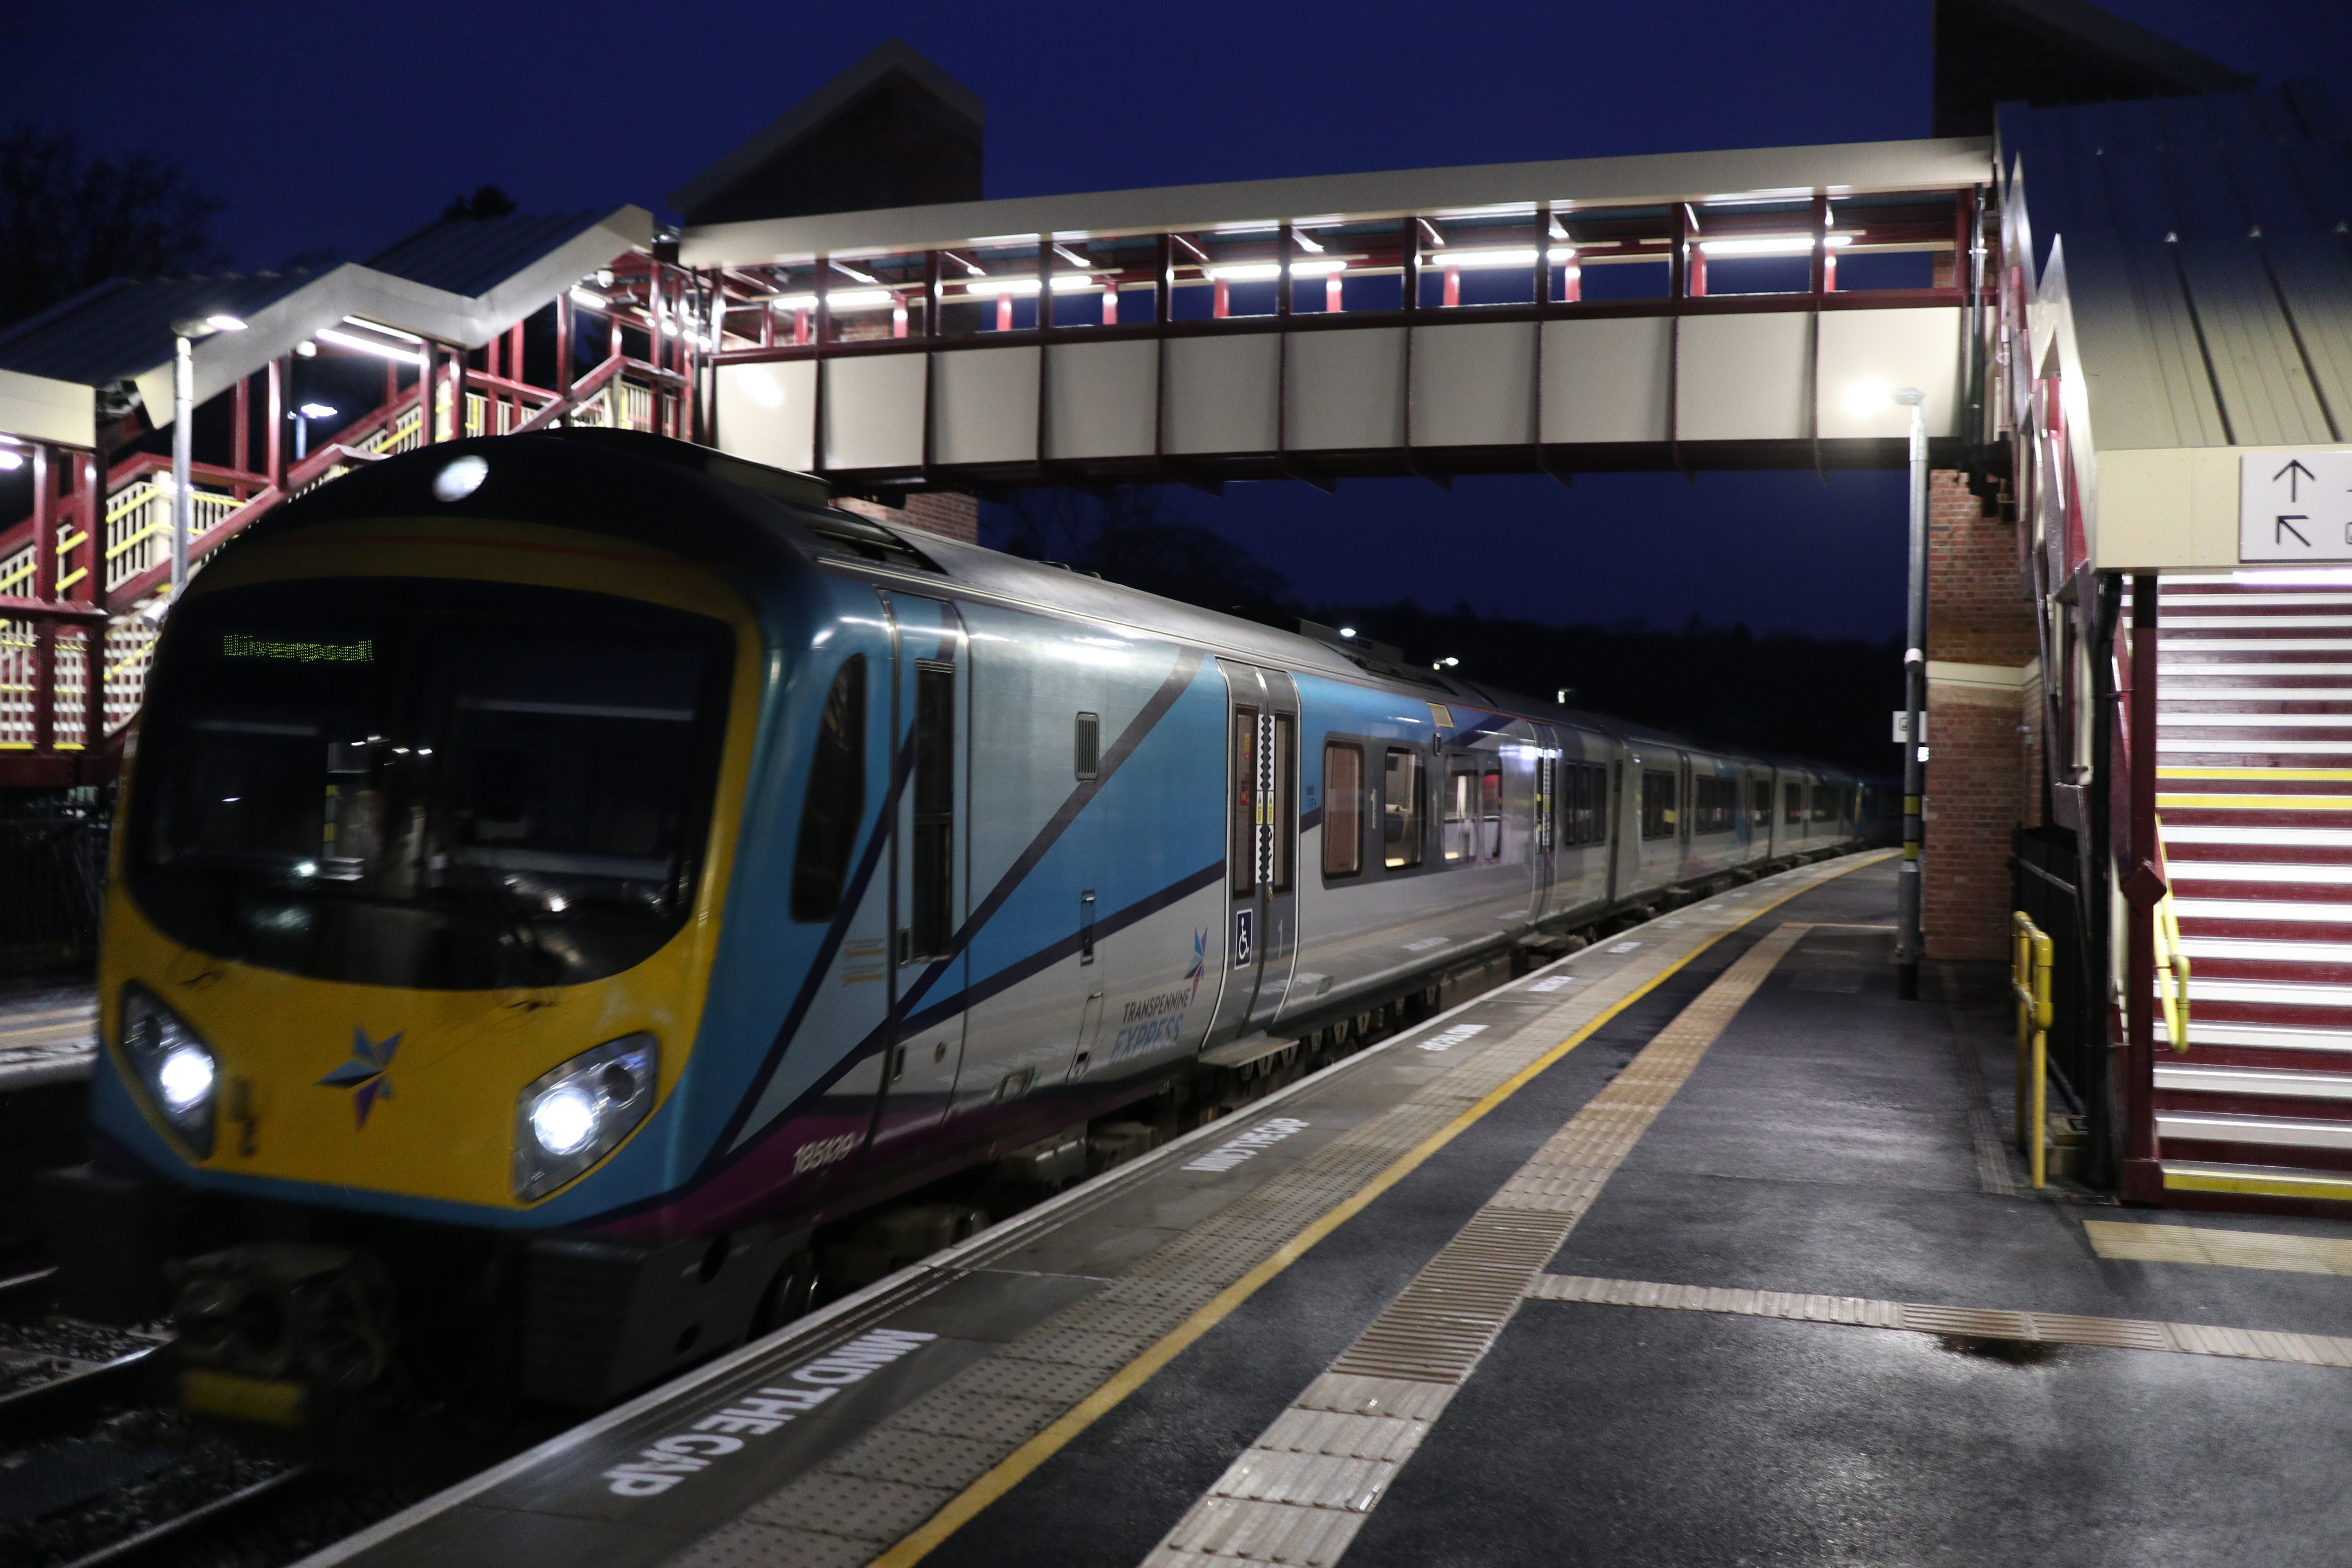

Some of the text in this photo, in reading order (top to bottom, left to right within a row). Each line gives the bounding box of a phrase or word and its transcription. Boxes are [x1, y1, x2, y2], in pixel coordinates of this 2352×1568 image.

[224, 634, 374, 662] Liverpool
[1122, 988, 1192, 1024] TRANSPENNINE
[1109, 1014, 1184, 1064] EXPRESS
[602, 1328, 938, 1497] MIND THE GAP
